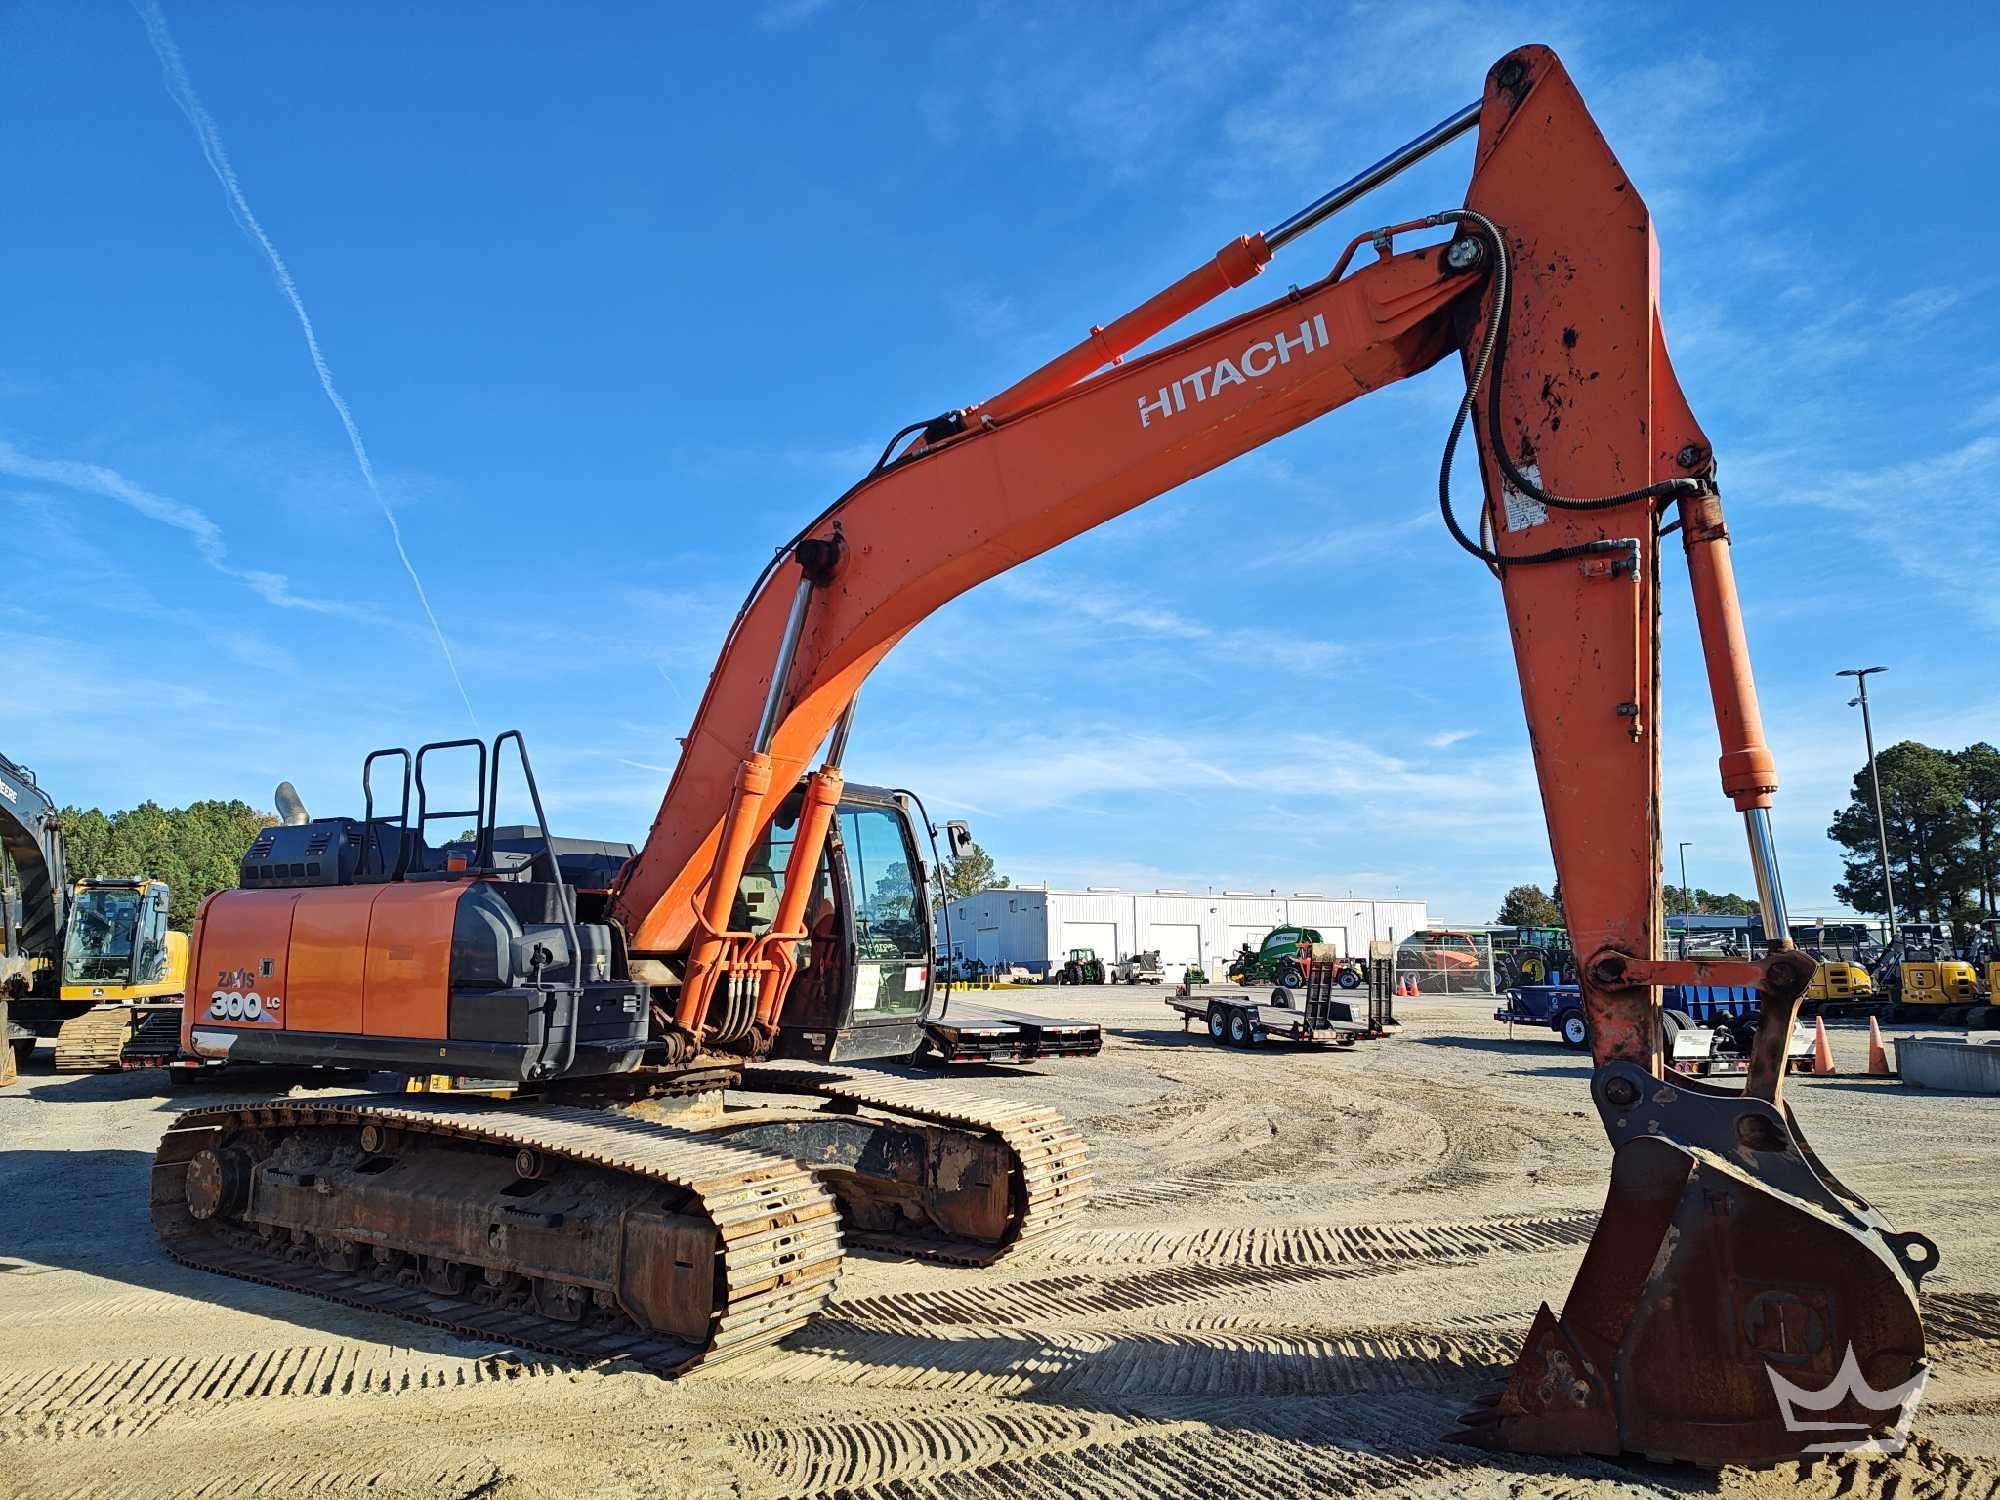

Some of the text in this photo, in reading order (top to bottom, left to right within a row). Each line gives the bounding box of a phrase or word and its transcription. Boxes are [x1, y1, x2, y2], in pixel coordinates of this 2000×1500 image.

[1137, 313, 1330, 428] HITACHI
[0, 777, 18, 804] EERE
[210, 990, 281, 1021] 300 LC
